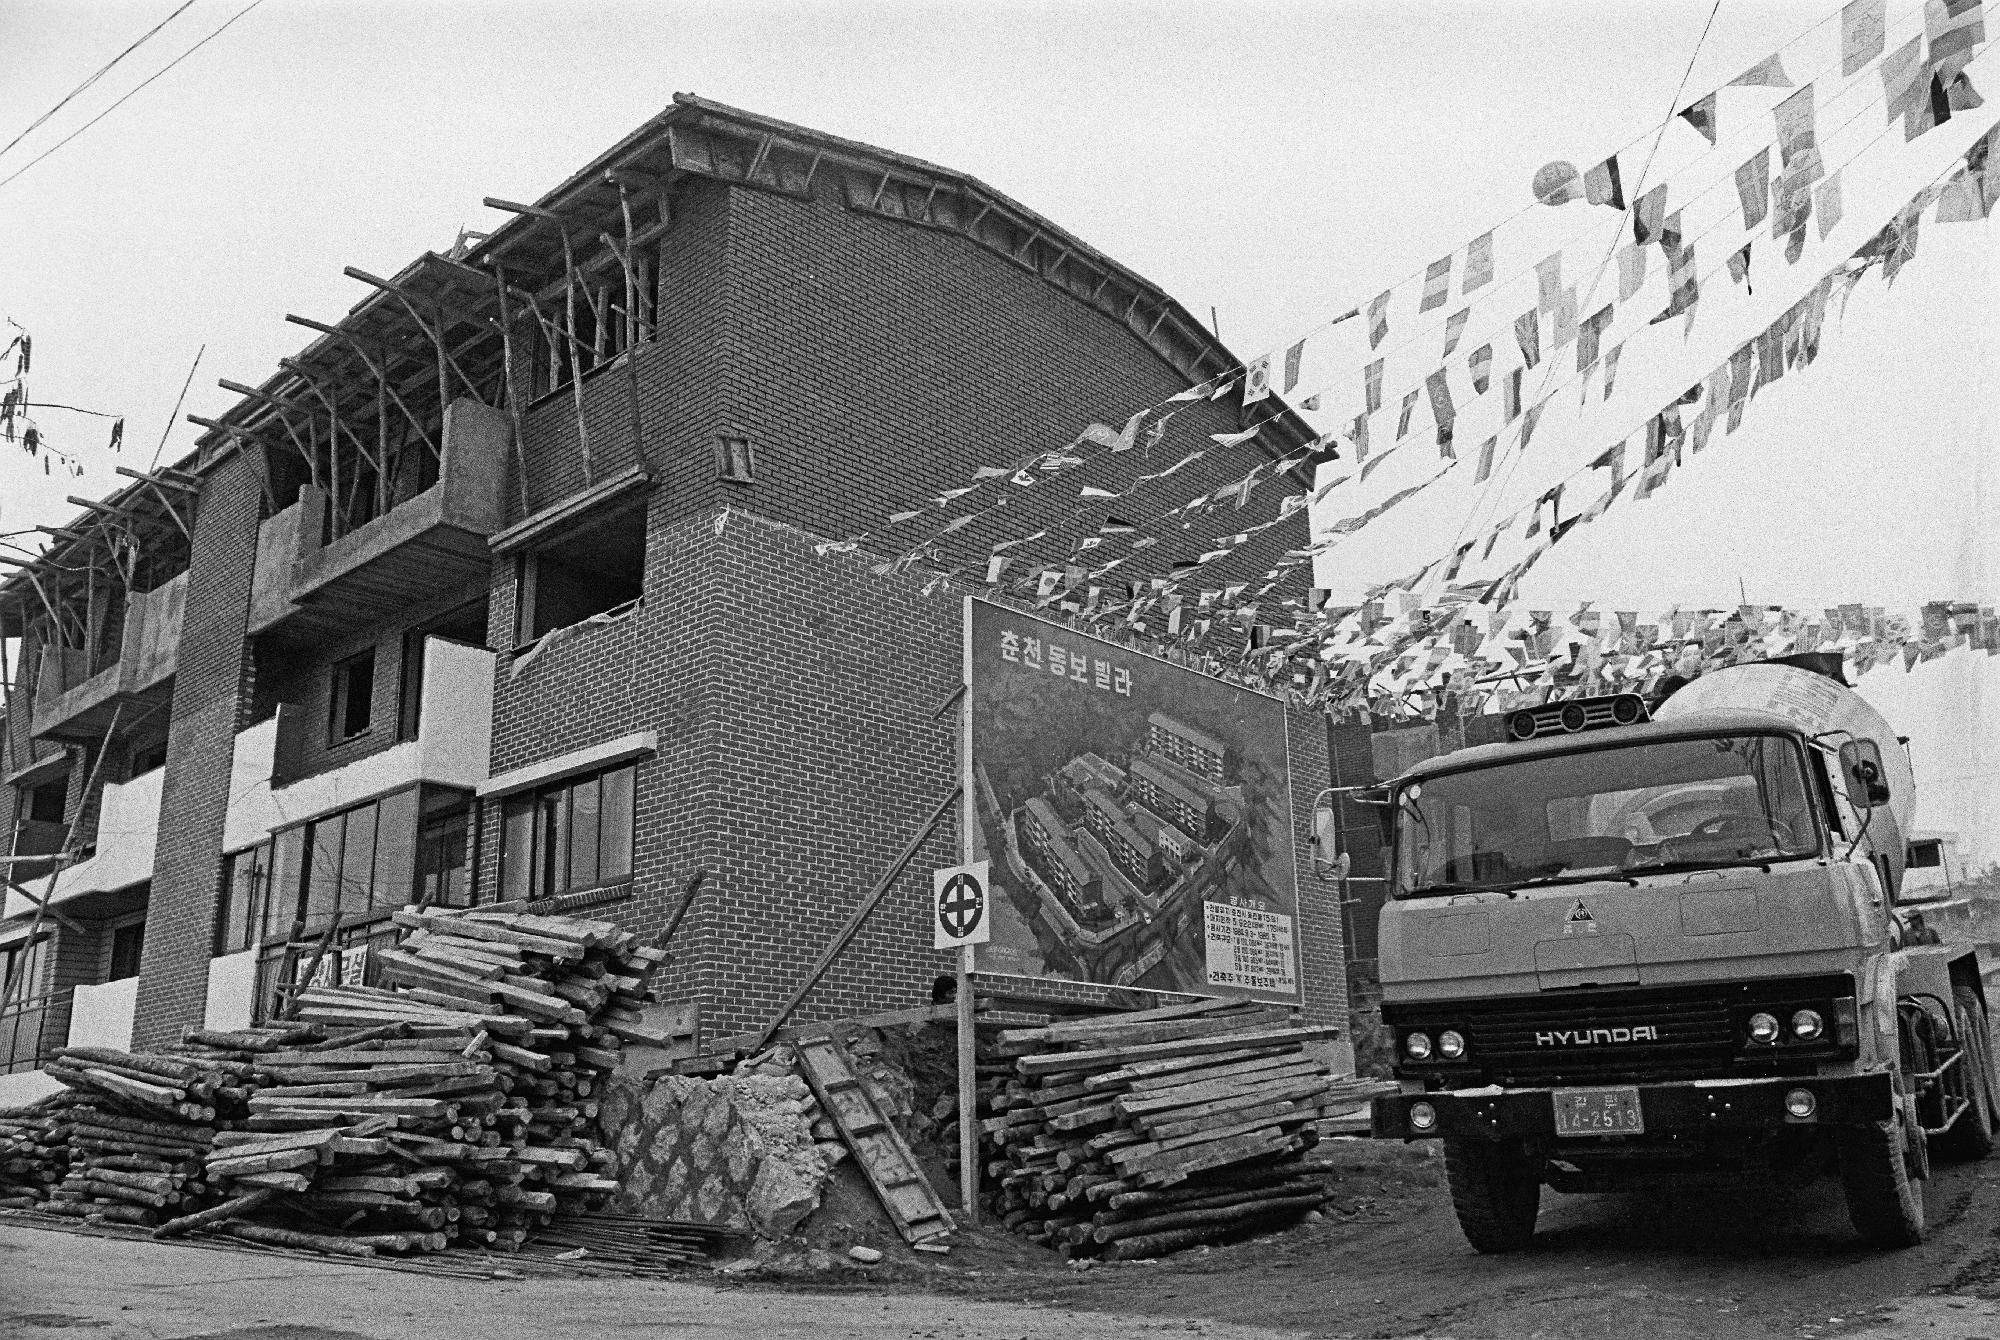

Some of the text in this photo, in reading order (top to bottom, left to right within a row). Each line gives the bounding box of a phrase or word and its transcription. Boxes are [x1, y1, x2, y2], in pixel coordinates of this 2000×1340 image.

[1001, 630, 1133, 696] 춘천 동보 빌라
[1536, 1026, 1657, 1046] HYUNDAI
